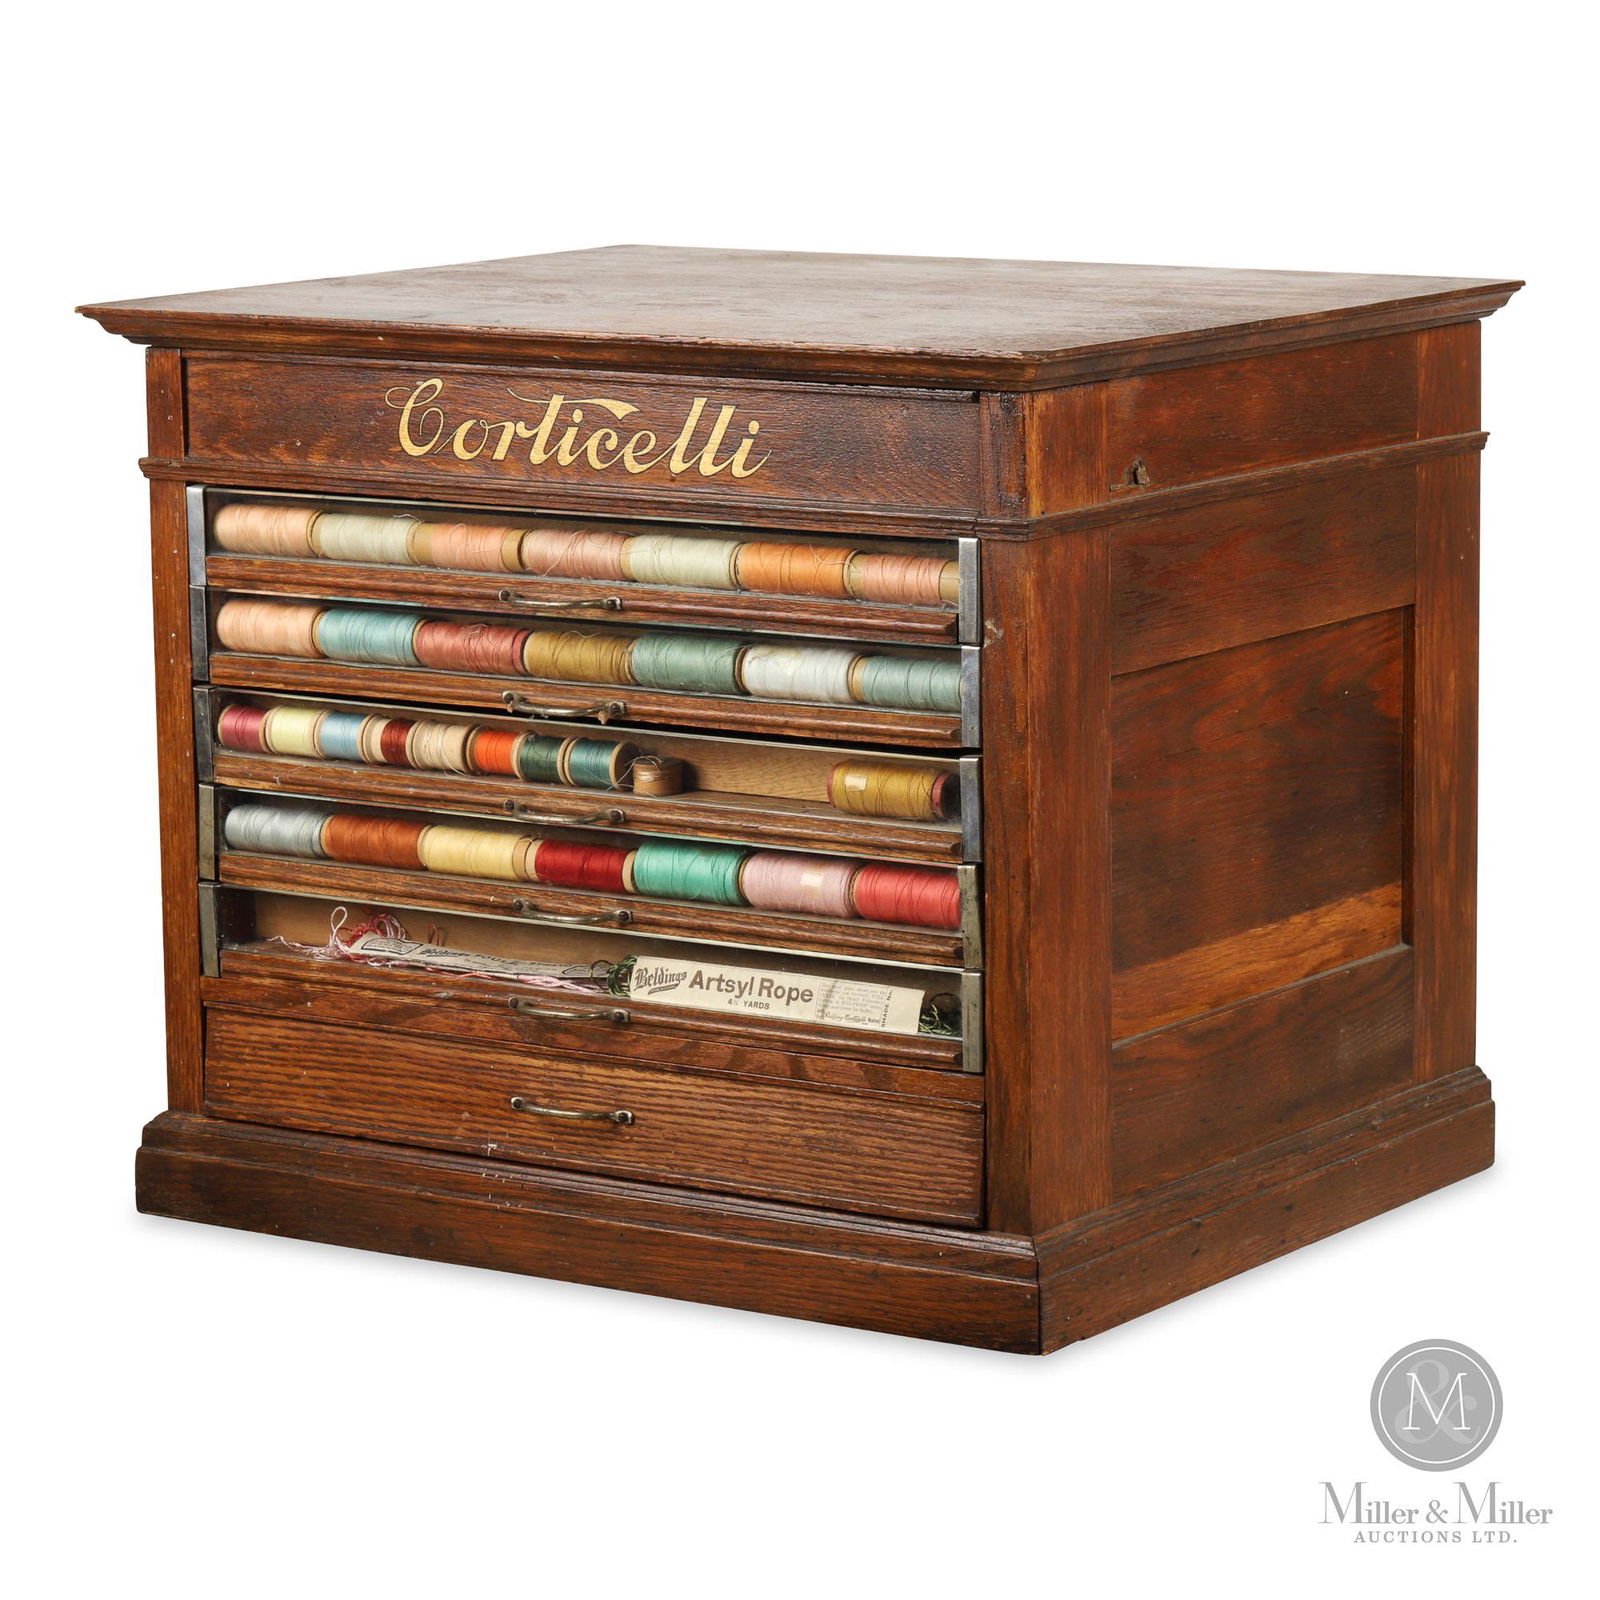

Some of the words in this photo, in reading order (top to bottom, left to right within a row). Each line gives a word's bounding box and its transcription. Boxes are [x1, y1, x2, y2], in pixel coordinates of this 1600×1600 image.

[384, 378, 773, 479] Corticelli
[633, 966, 687, 991] Beldings
[688, 969, 755, 998] Artsyl
[757, 977, 814, 1006] Rope
[743, 1000, 770, 1010] YARDS
